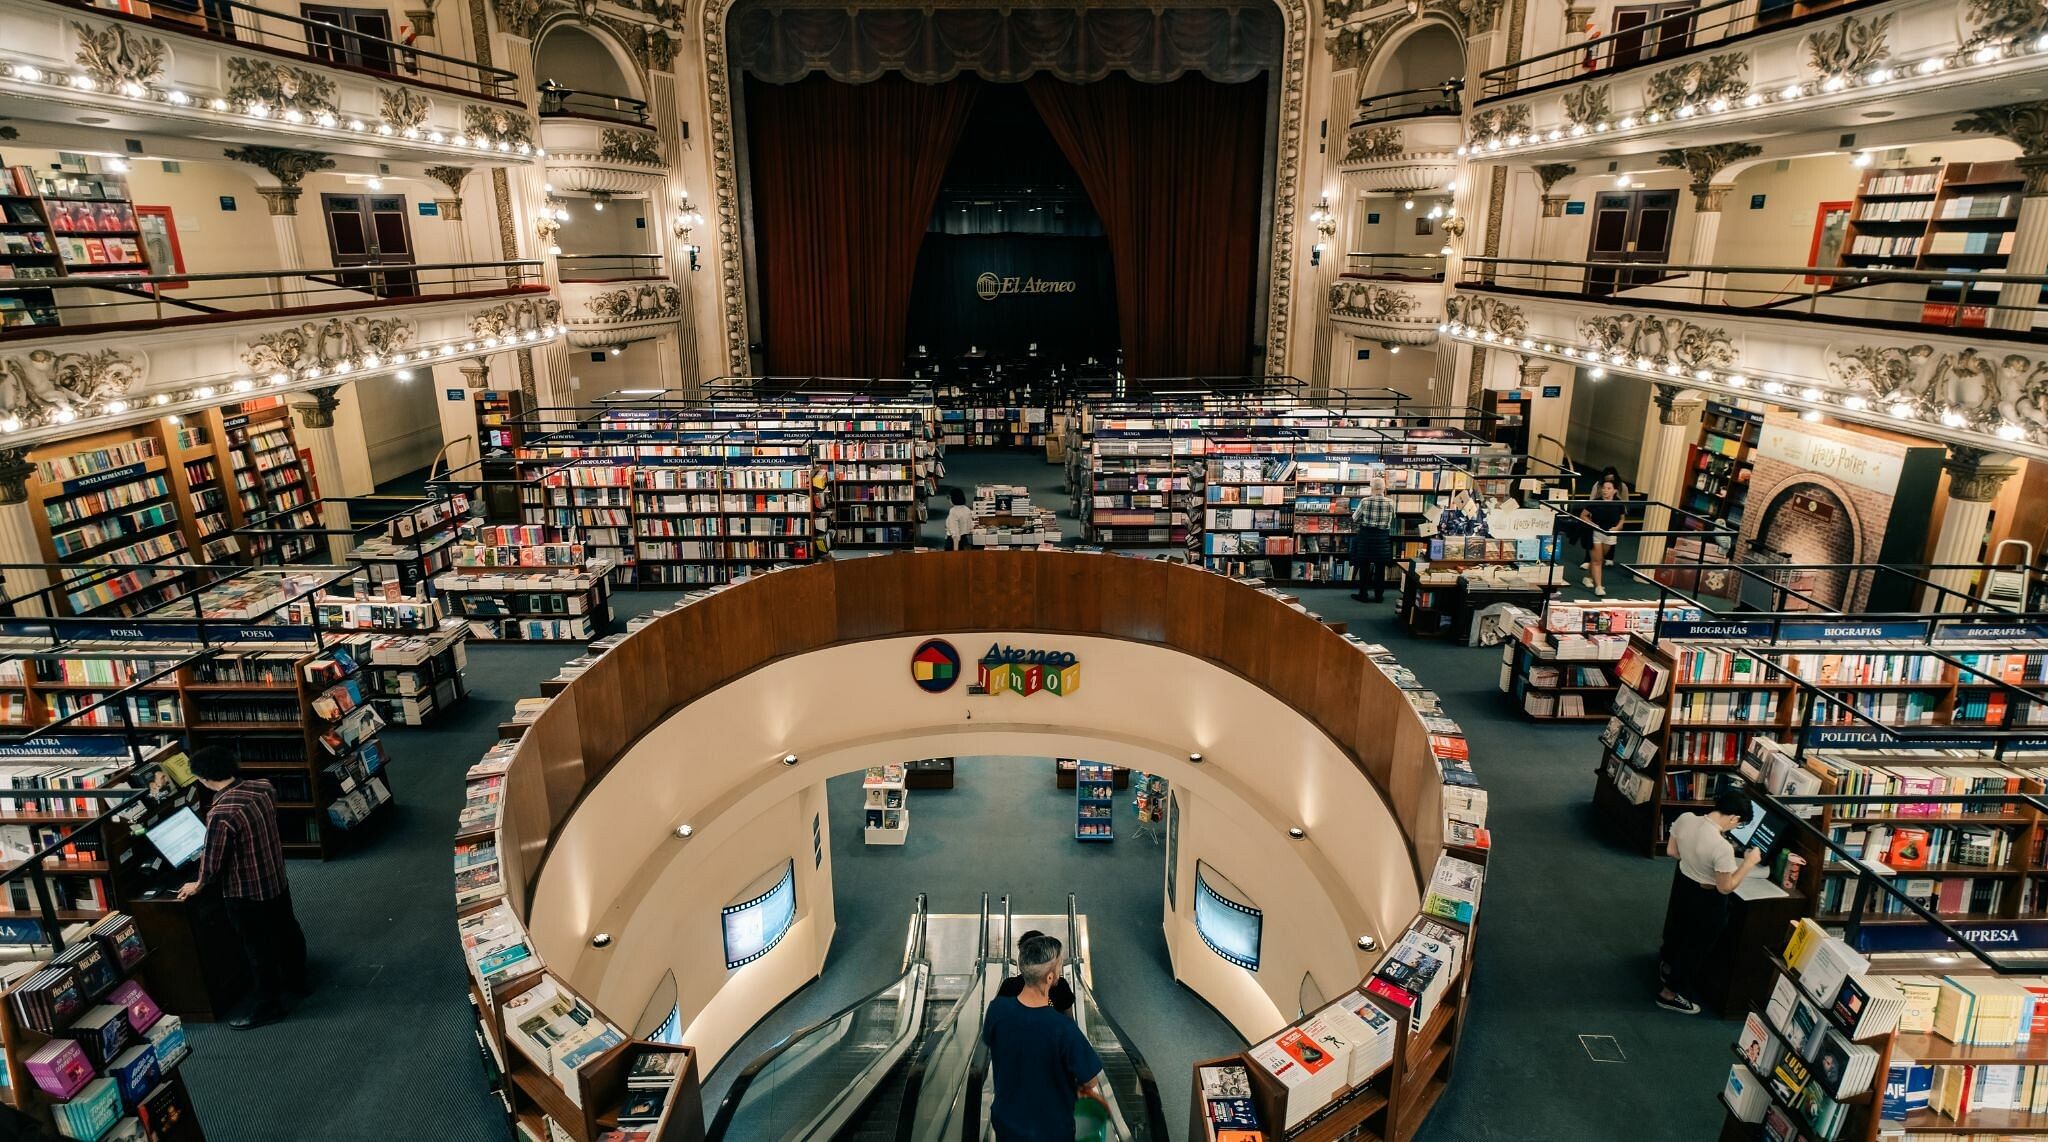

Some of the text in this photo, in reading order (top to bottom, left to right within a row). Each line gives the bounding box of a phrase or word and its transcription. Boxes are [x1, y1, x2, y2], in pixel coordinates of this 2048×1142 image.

[1000, 276, 1076, 293] El Ateneo
[1811, 443, 1868, 476] Harry Potter
[79, 478, 102, 487] NOVELA
[110, 628, 144, 637] POESIA
[240, 630, 275, 638] POESIA
[1690, 625, 1747, 635] BIOGRAFÍAS
[1824, 628, 1882, 636] BIOGRAFIAS
[984, 642, 1076, 665] Ateneo
[979, 667, 1079, 690] Junior
[1820, 732, 1877, 742] POLITICA
[1385, 961, 1401, 976] 24
